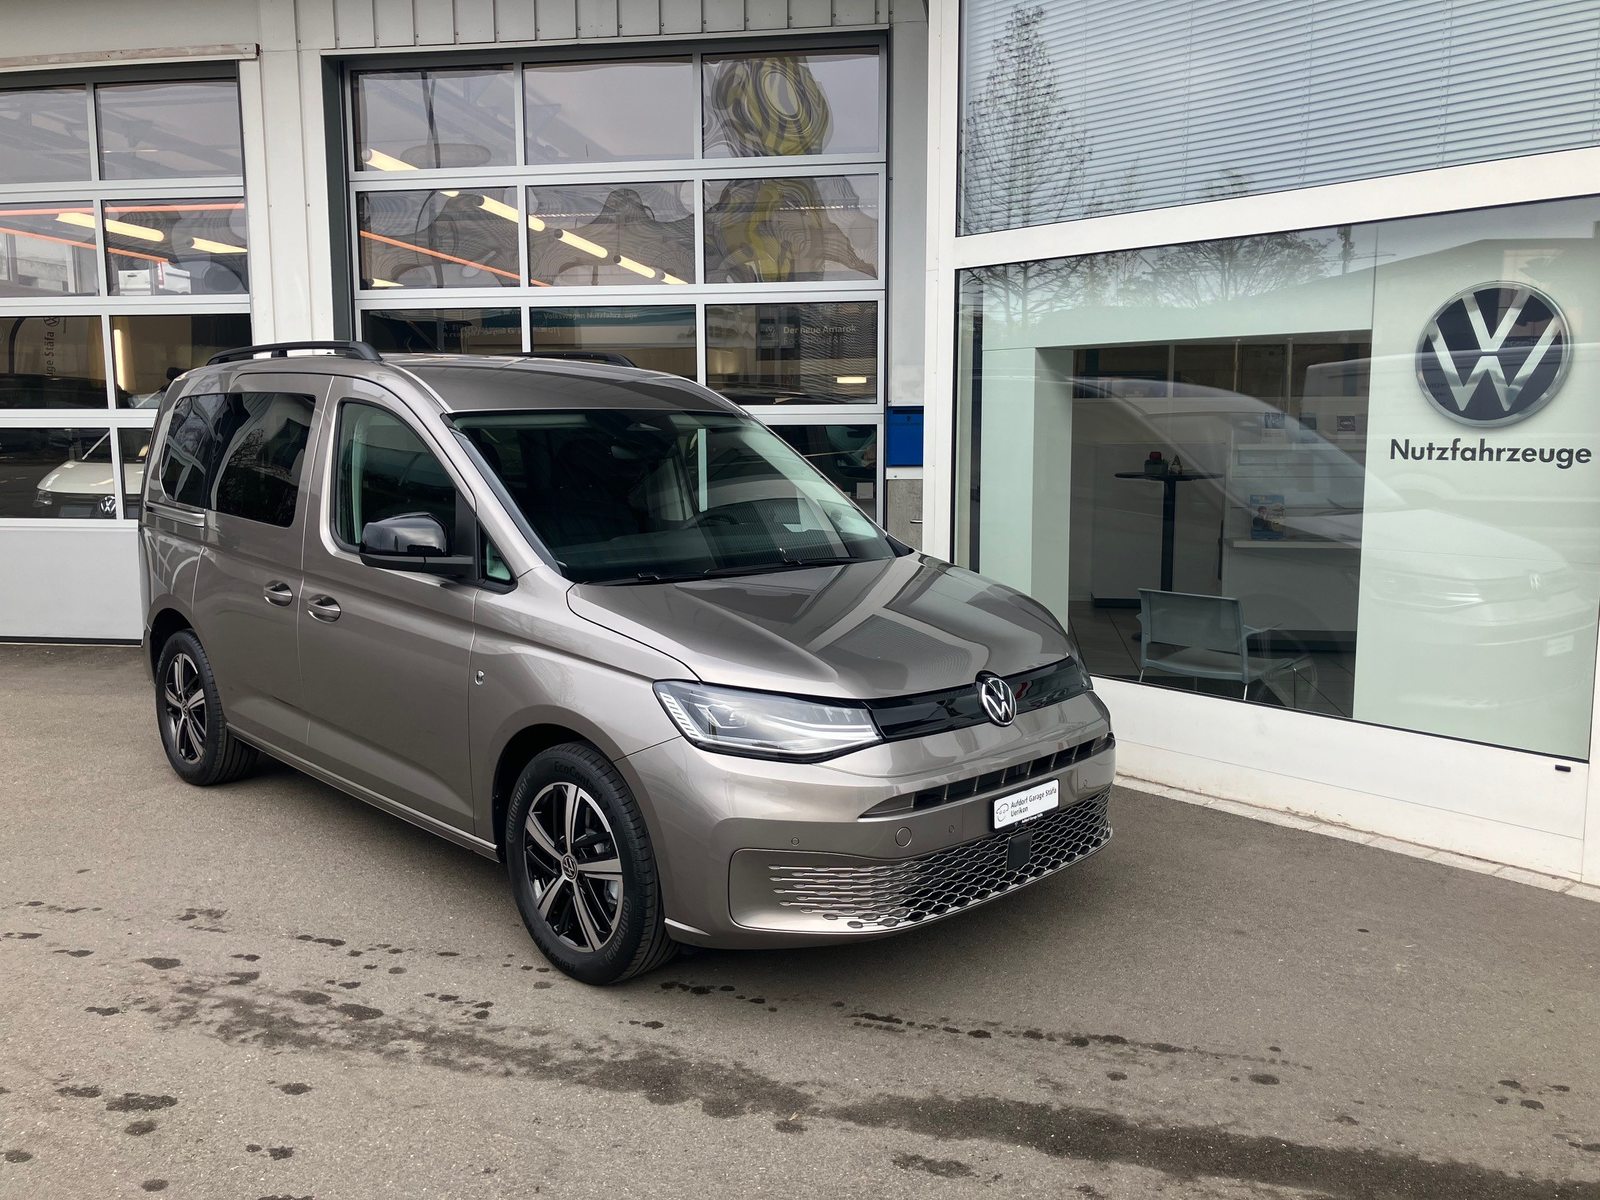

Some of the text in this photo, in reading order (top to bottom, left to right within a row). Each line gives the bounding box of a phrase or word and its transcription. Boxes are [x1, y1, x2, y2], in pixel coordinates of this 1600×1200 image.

[783, 326, 799, 334] Der
[823, 324, 857, 334] Amarok
[1390, 438, 1592, 469] Nutzfahrzeuge
[1010, 787, 1057, 809] Aufdorf Garage Stäfa
[1010, 806, 1029, 818] Uerikon
